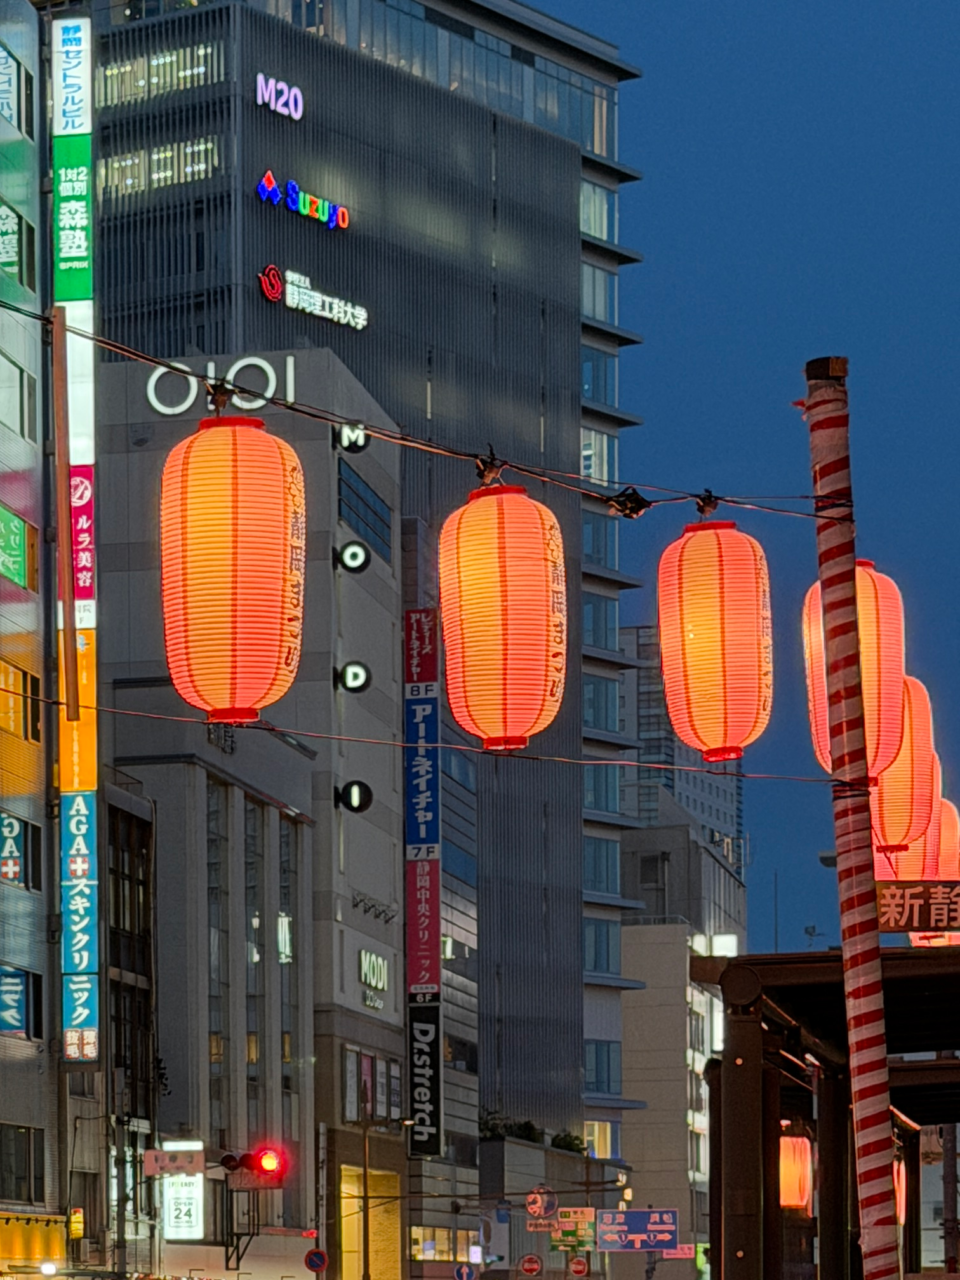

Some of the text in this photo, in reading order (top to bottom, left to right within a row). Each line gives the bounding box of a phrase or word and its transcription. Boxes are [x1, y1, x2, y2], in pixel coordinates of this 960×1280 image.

[61, 24, 84, 131] 静岡セントラルビル
[256, 72, 304, 120] M20
[58, 166, 88, 182] 1対2
[58, 182, 87, 197] 個別
[58, 200, 89, 258] 森塾
[58, 260, 88, 270] SPRIX
[77, 515, 93, 587] ルラ美容
[409, 613, 422, 681] アートネイチャー
[421, 613, 433, 654] レディース
[411, 704, 434, 839] アートネイチャー
[69, 795, 92, 1026] AGA スキンクリニック
[416, 861, 431, 983] 静岡中央クリニック
[361, 949, 387, 991] MODI
[416, 994, 432, 1003] 6F
[413, 1021, 437, 1141] Dr.stretch
[174, 1208, 192, 1219] 24
